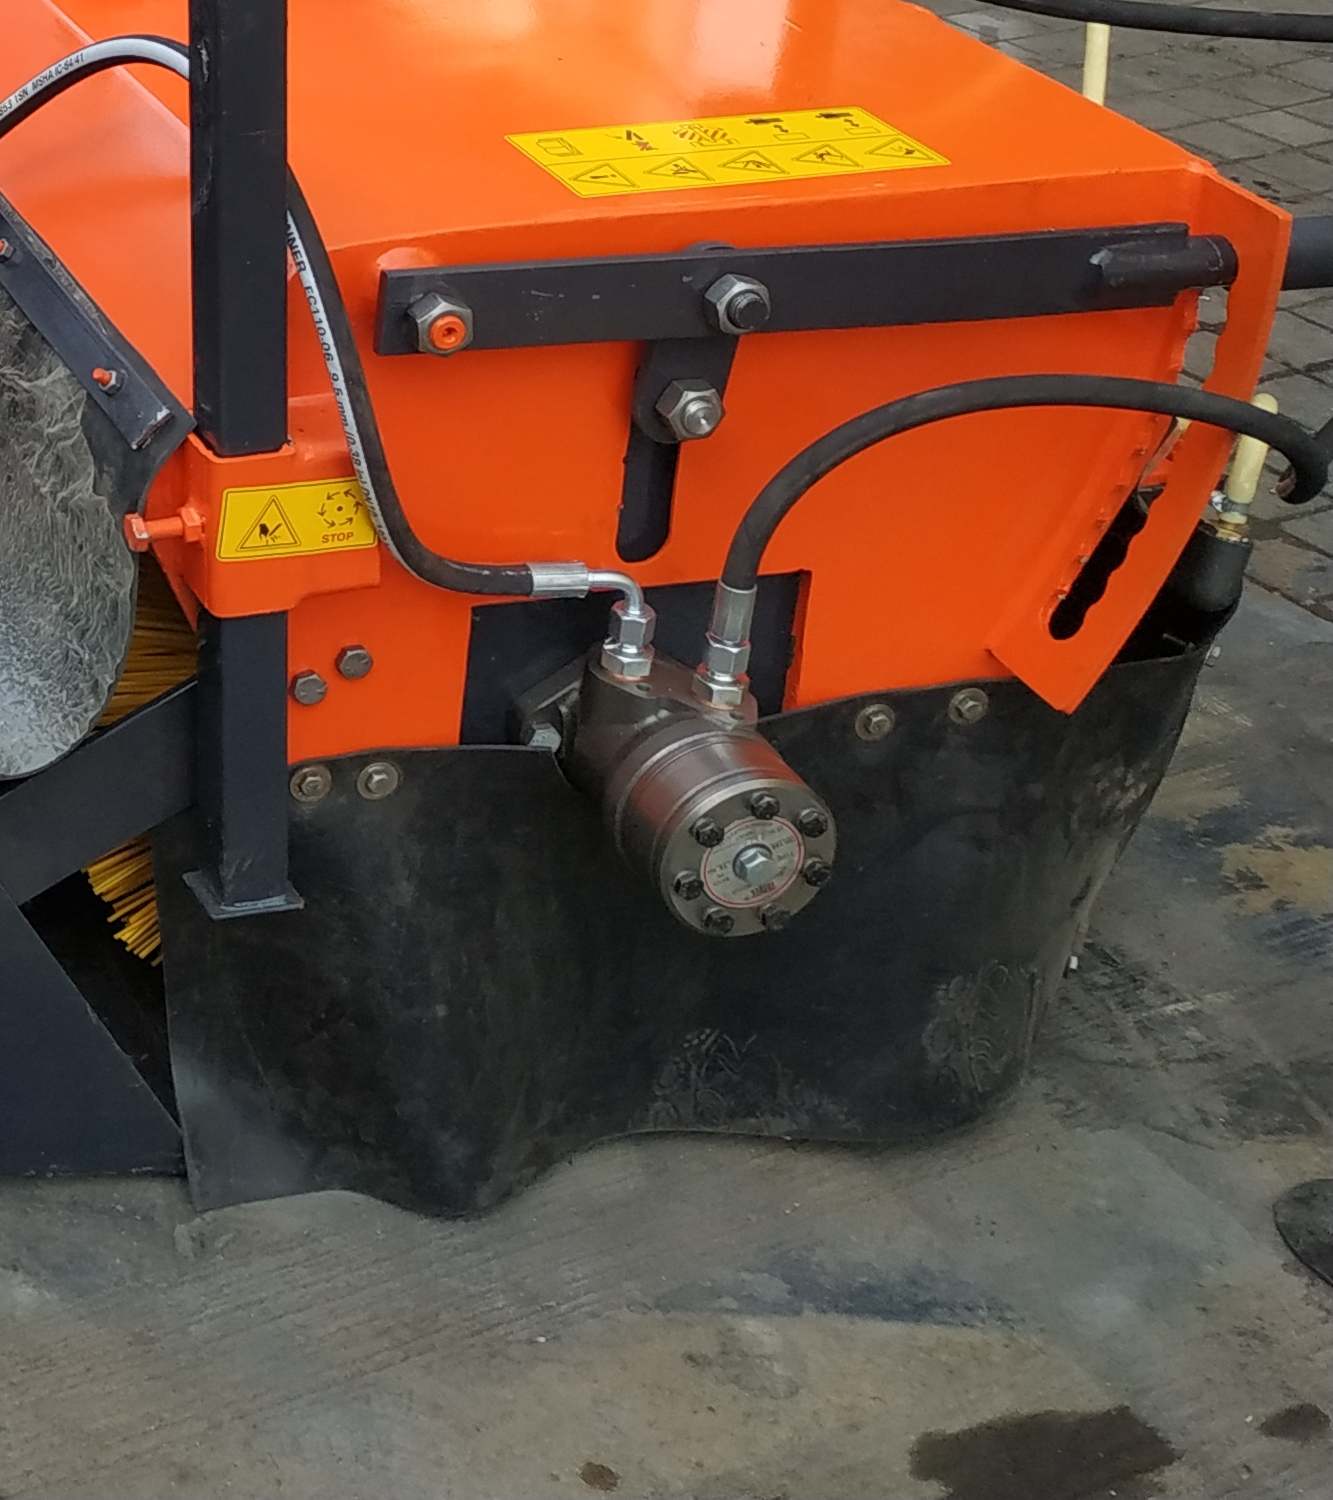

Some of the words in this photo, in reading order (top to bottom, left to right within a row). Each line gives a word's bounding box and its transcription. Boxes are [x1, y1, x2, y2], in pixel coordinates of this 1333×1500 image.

[14, 86, 30, 104] 1SN
[31, 70, 55, 92] MSHA
[321, 531, 355, 544] STOP
